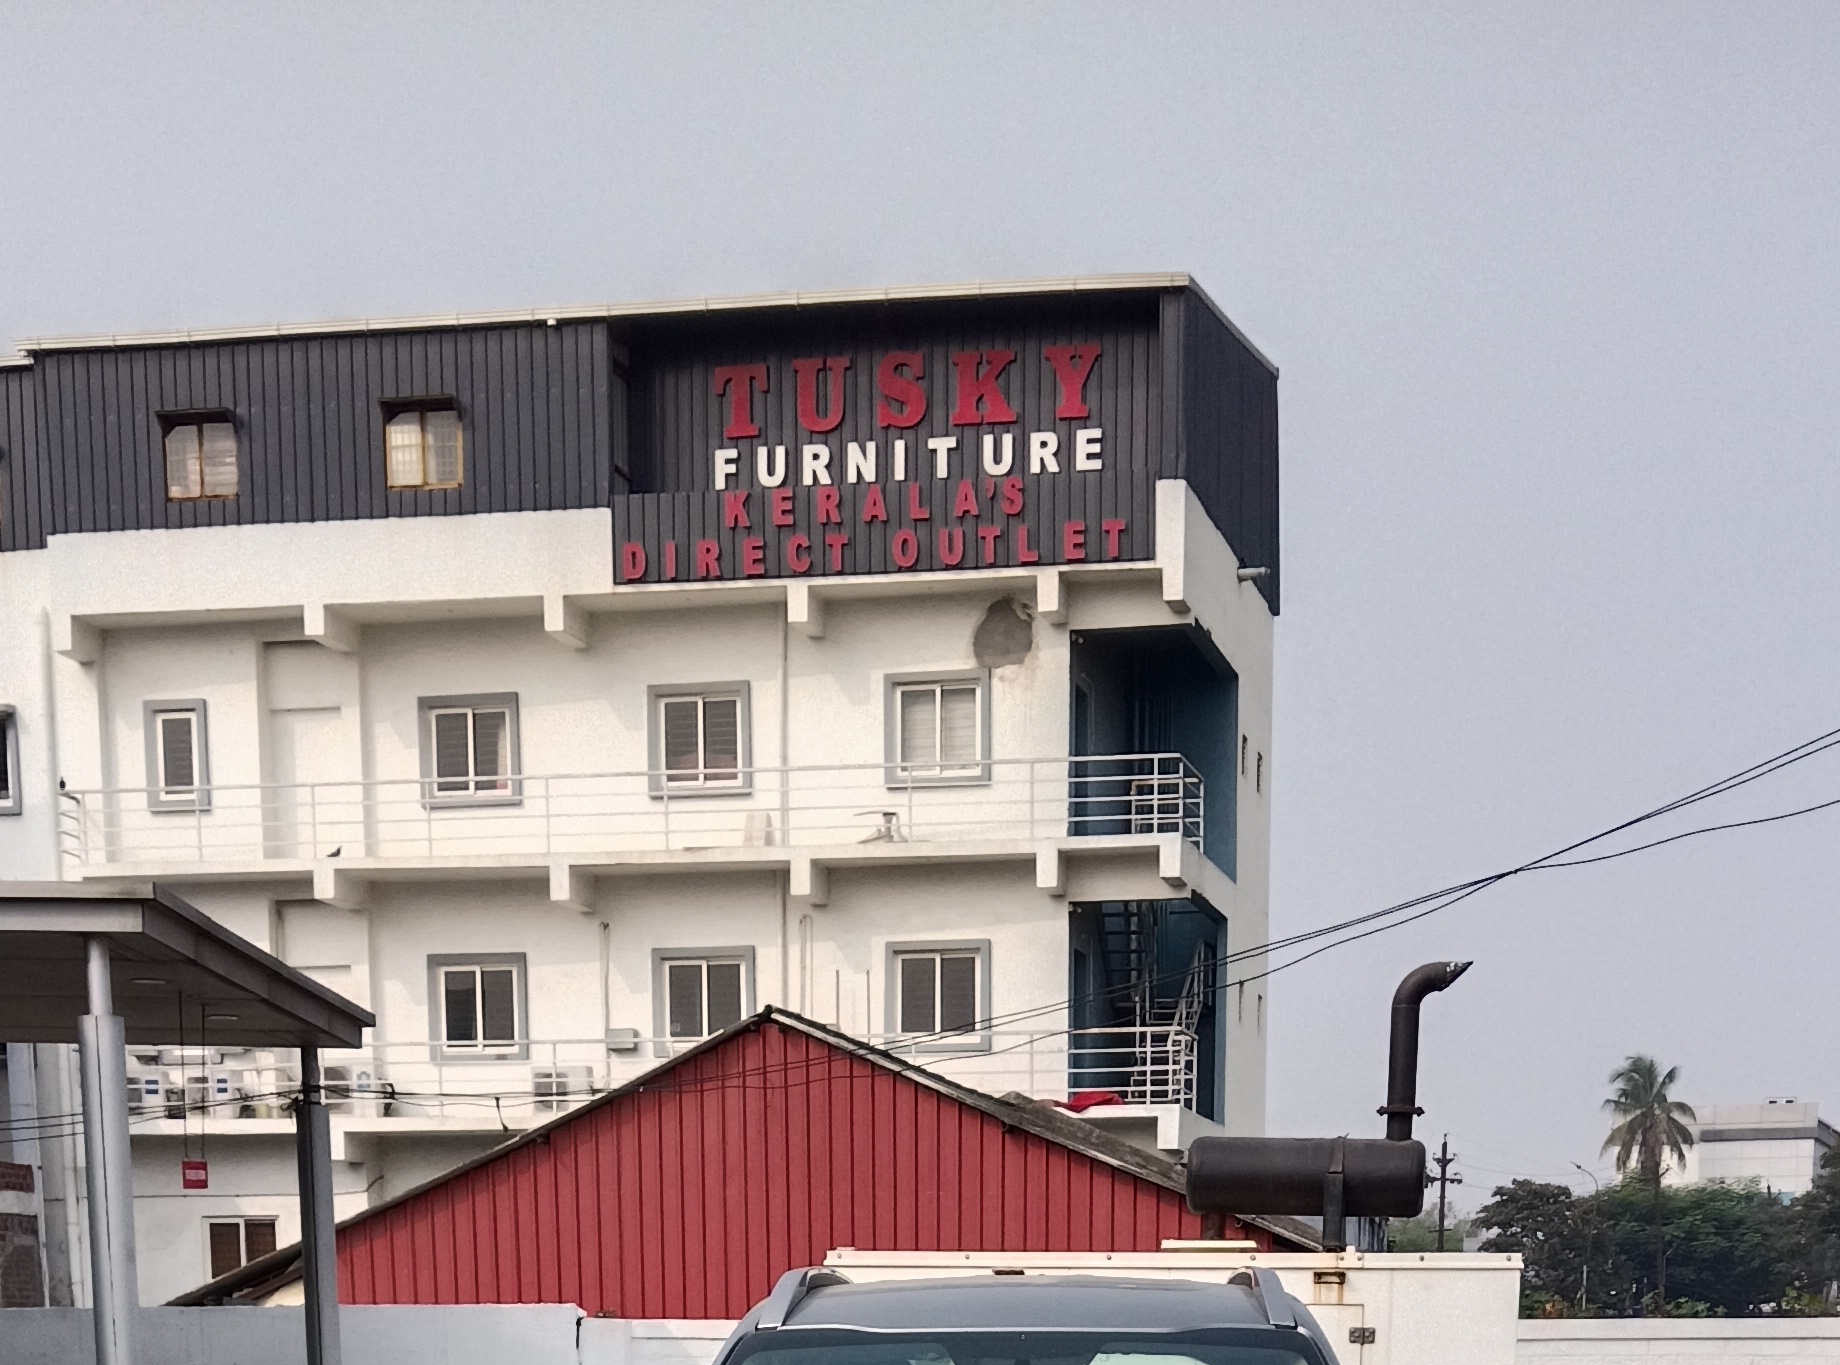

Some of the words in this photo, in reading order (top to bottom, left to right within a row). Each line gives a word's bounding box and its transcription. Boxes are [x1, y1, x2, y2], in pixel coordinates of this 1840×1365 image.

[715, 345, 1102, 439] TUSKY
[714, 428, 1103, 490] FURNITURE
[725, 476, 1024, 528] KERALA'S
[623, 534, 849, 582] DIRECT
[892, 519, 1126, 569] OUTLET
